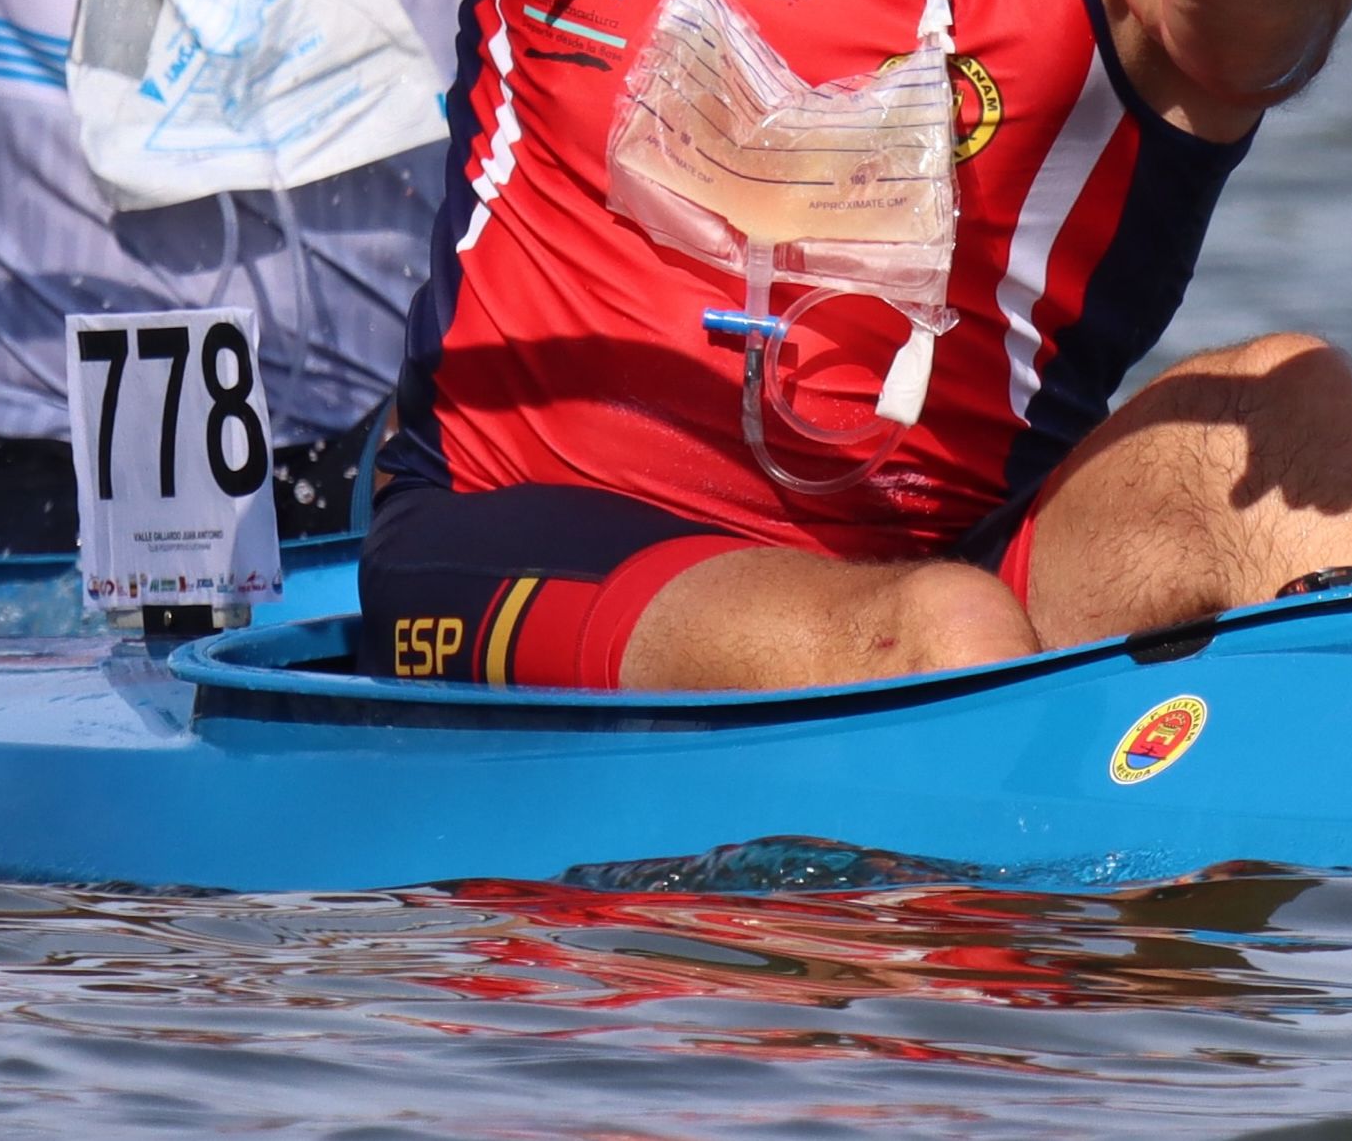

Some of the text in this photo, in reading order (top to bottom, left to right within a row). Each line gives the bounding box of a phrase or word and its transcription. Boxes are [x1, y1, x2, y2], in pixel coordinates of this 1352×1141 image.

[962, 60, 999, 112] ANAM
[808, 199, 885, 210] APPROXIMATE
[77, 322, 269, 501] 778
[395, 618, 464, 677] ESP
